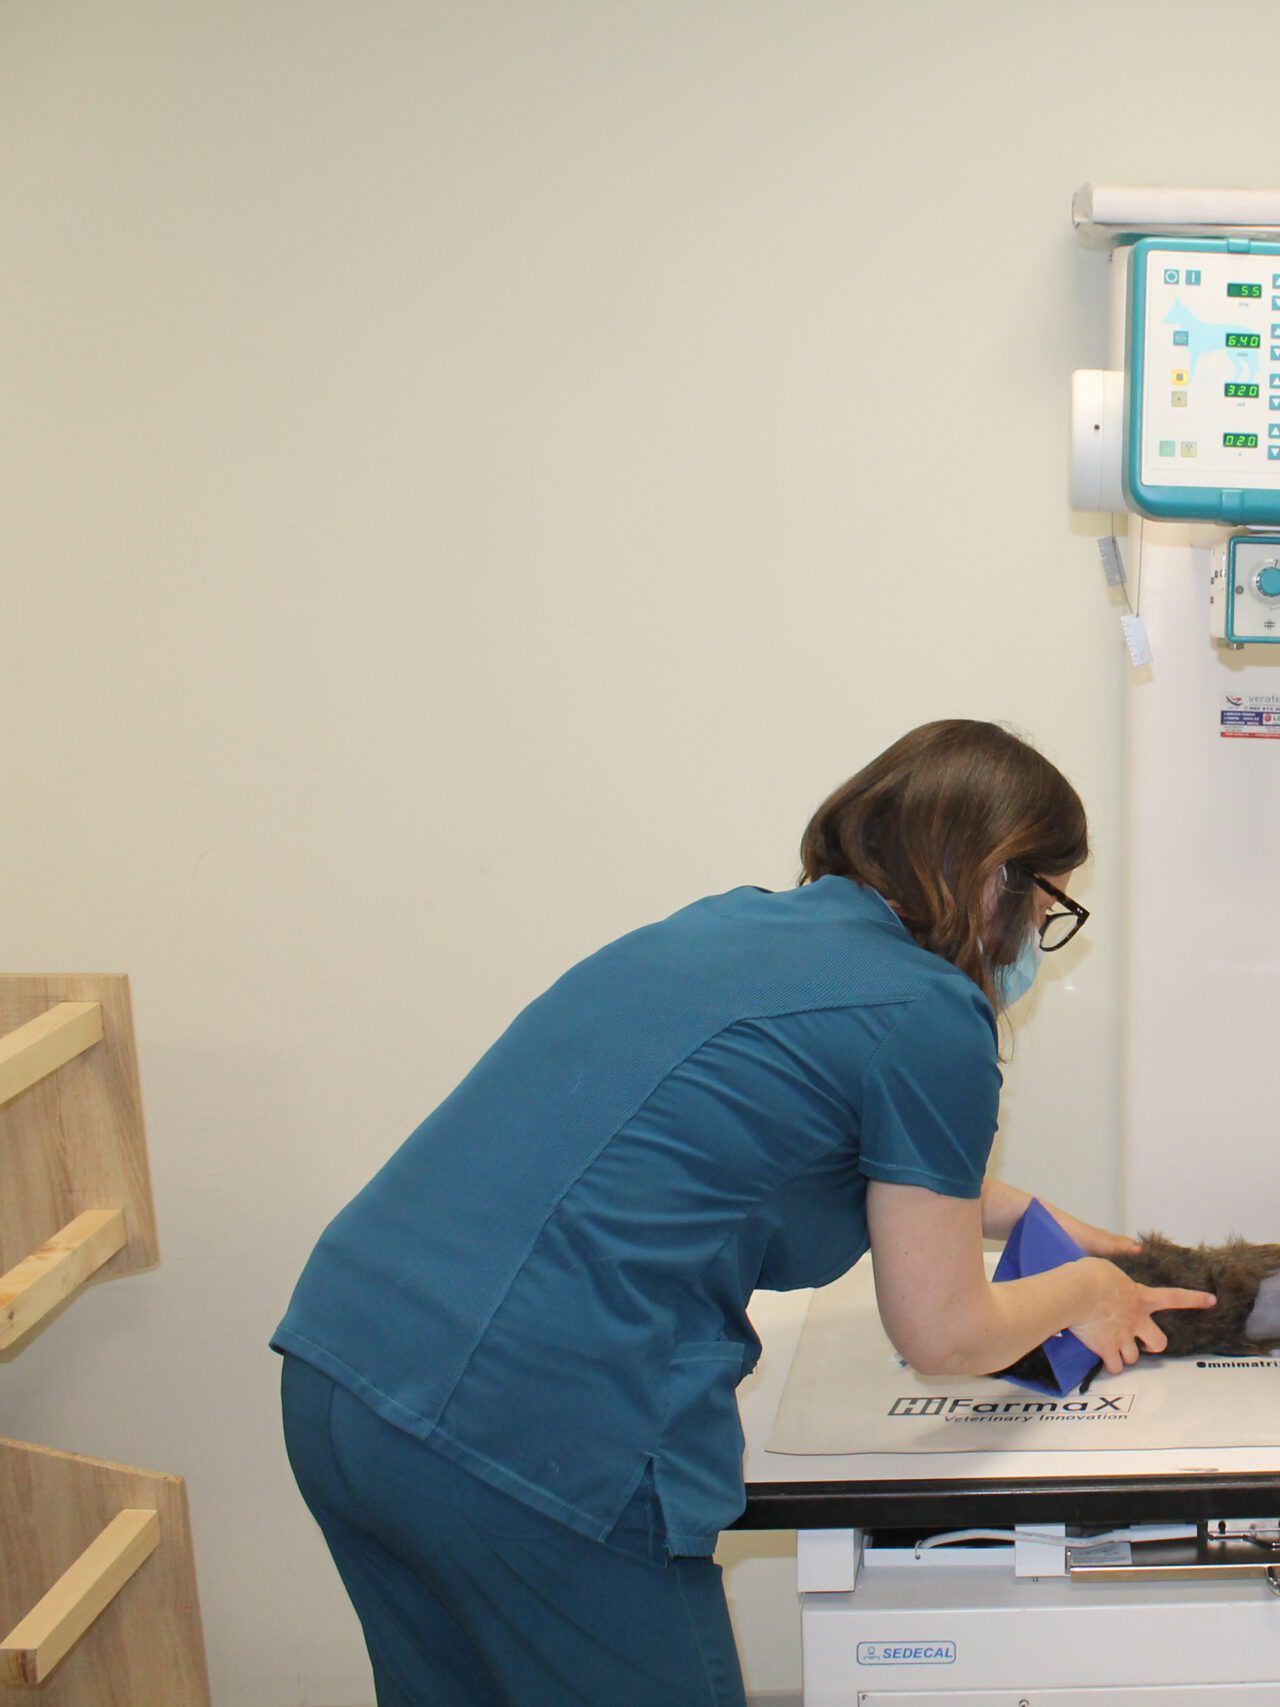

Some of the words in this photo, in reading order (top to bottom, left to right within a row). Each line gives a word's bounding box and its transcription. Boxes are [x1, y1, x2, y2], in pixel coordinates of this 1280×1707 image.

[1241, 285, 1260, 297] 55
[1227, 384, 1258, 397] 320
[1225, 435, 1257, 447] 020
[944, 1415, 1033, 1423] Veterinary
[1039, 1412, 1128, 1421] Innovation
[882, 1647, 954, 1660] SEDECAL
